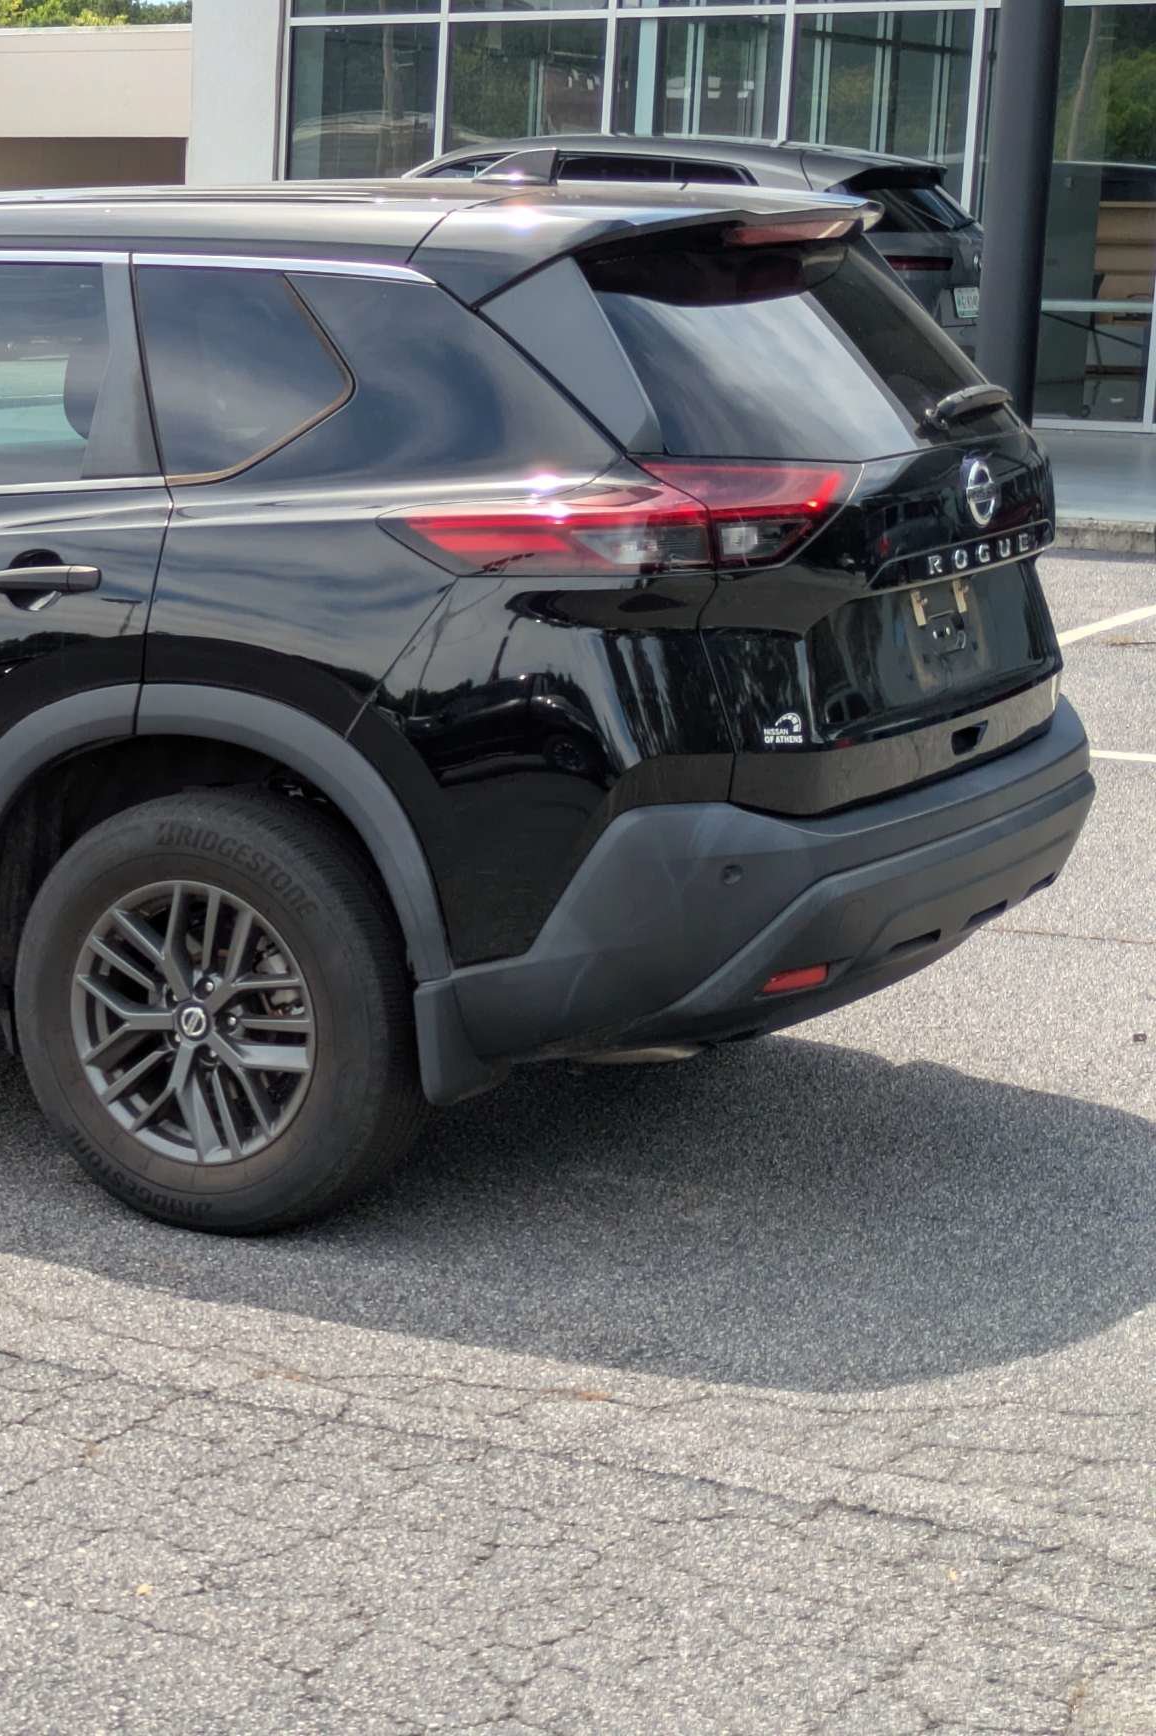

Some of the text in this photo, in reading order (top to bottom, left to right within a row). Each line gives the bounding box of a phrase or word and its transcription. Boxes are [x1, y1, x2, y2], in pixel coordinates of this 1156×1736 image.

[927, 533, 1029, 575] ROGUE
[764, 735, 803, 743] OF ATHENS
[155, 819, 320, 919] BRIDGESTONE
